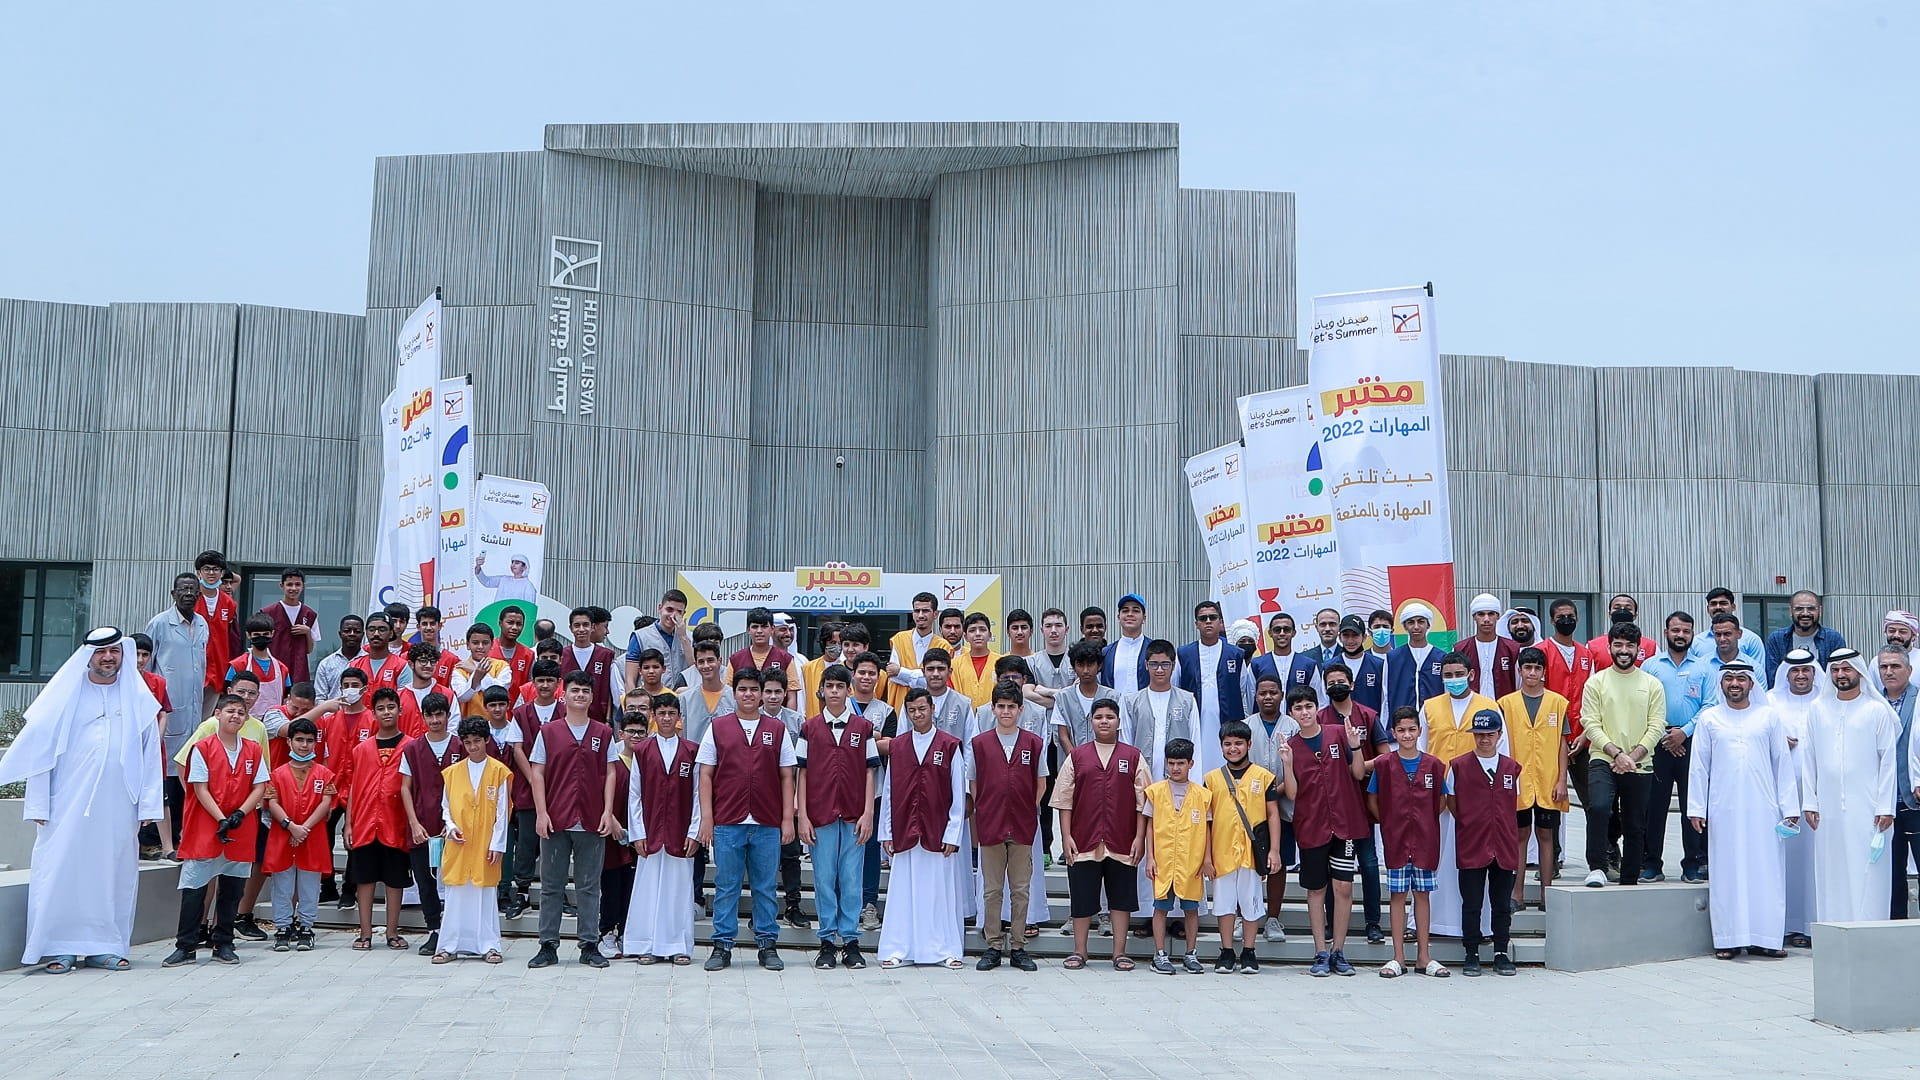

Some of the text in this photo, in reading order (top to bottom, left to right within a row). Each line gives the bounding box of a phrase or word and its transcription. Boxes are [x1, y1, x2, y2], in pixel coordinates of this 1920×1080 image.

[1313, 325, 1378, 344] et's Summer
[1314, 319, 1335, 331] ويان
[547, 296, 573, 414] ناشئة واسط
[580, 299, 598, 416] WASIT YOUTH
[1334, 375, 1413, 418] مختبر
[1265, 416, 1297, 427] Summer
[1322, 415, 1430, 443] المهارات 2022
[1332, 468, 1433, 499] حيث تلتقي
[1336, 500, 1431, 522] المهارة بالمتعة
[1267, 513, 1325, 545] مختبر
[441, 533, 468, 553] لمهارا
[480, 533, 512, 547] الناشئة
[1256, 540, 1337, 563] المهارات 2022
[718, 579, 739, 591] ويانا
[805, 563, 871, 592] مختبر
[710, 591, 779, 601] Let's Summer
[1295, 585, 1334, 601] حيث
[792, 595, 884, 613] المهارات 2022
